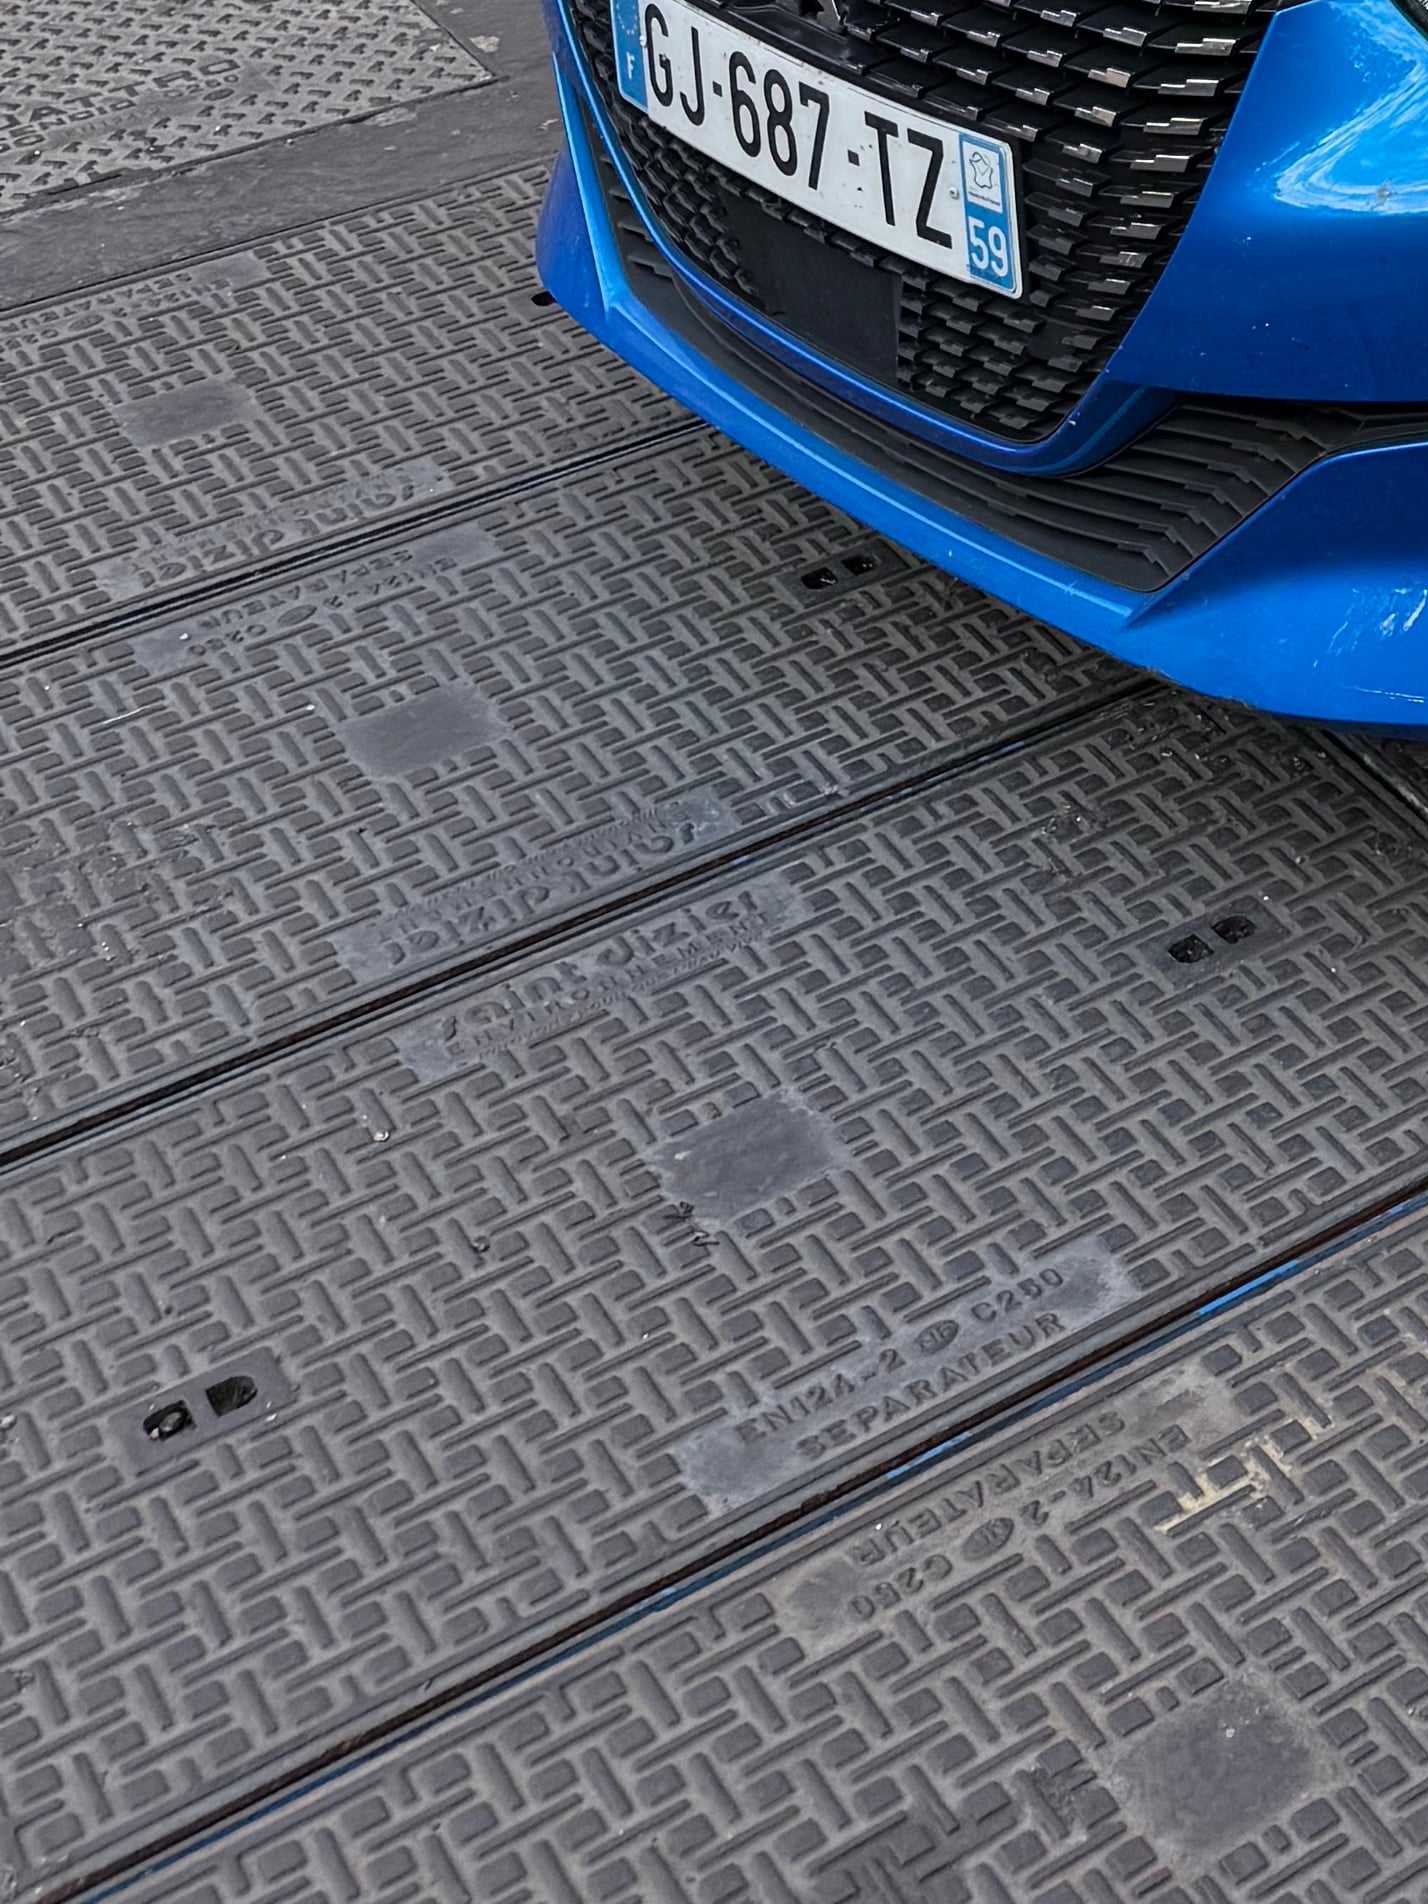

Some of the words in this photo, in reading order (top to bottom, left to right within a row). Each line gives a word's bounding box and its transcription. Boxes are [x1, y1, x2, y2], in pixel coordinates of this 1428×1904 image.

[626, 51, 636, 80] F
[643, 2, 953, 251] GJ-687-TZ
[968, 215, 1009, 278] 59
[797, 1312, 1067, 1460] SEPARATEUR
[848, 1411, 1128, 1567] SEPARATEUR
